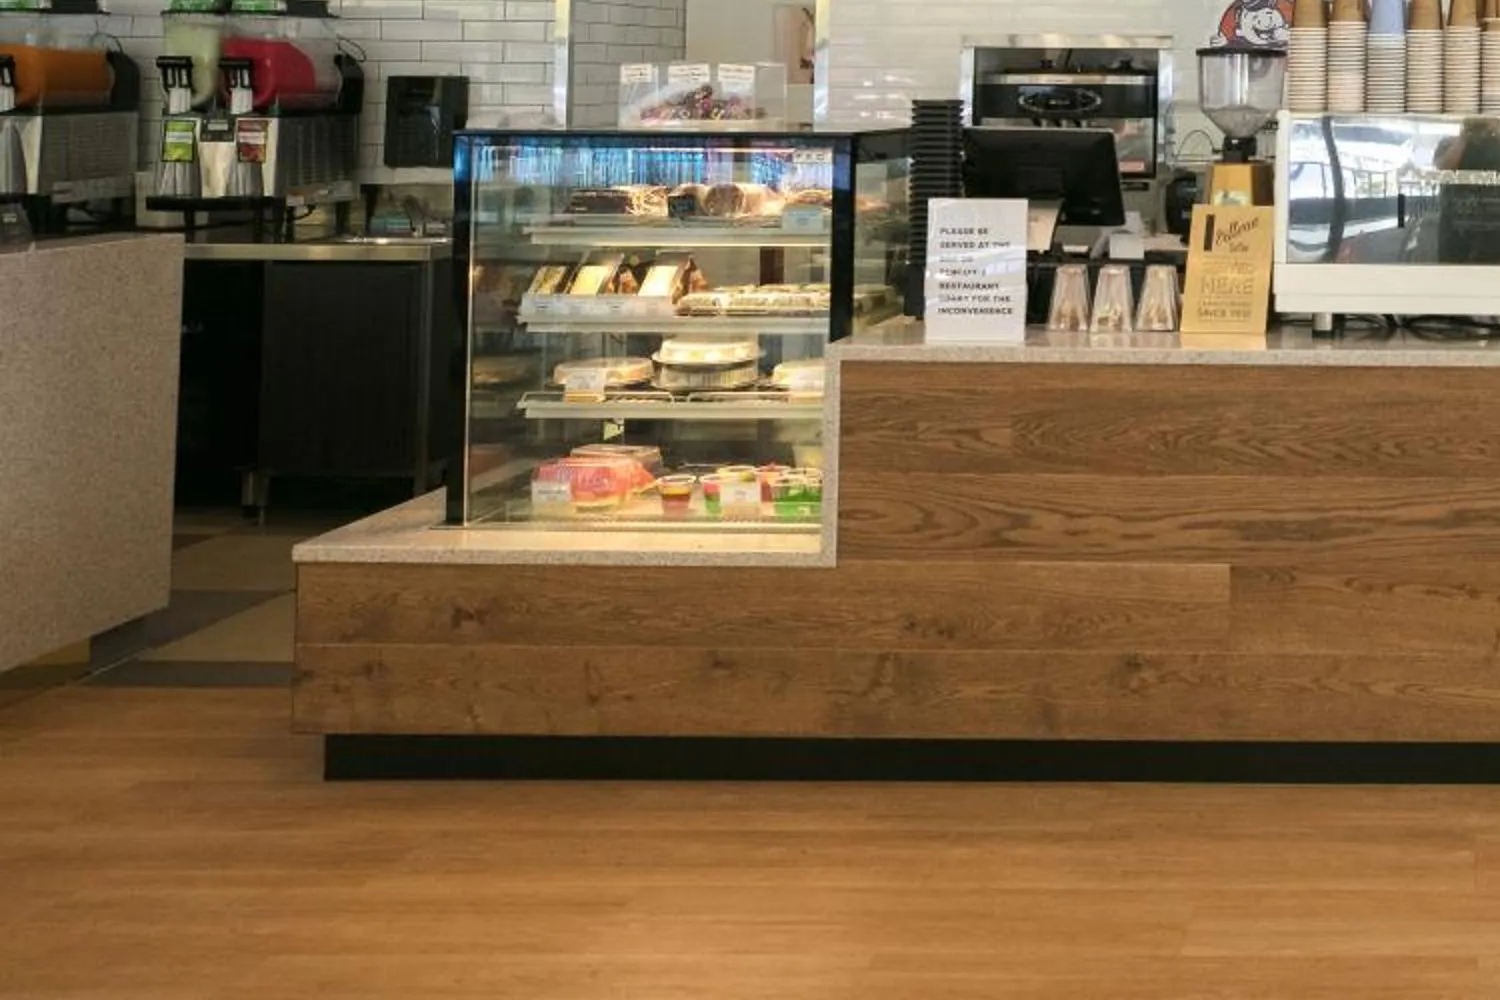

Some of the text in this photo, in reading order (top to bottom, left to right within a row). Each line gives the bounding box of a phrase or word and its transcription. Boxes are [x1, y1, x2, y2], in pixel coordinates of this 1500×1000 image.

[939, 227, 975, 235] PLEASE
[939, 241, 976, 249] SERVED
[977, 241, 990, 249] AT
[938, 282, 999, 290] RESTAURANT
[937, 307, 1013, 315] INCONVENIENCE
